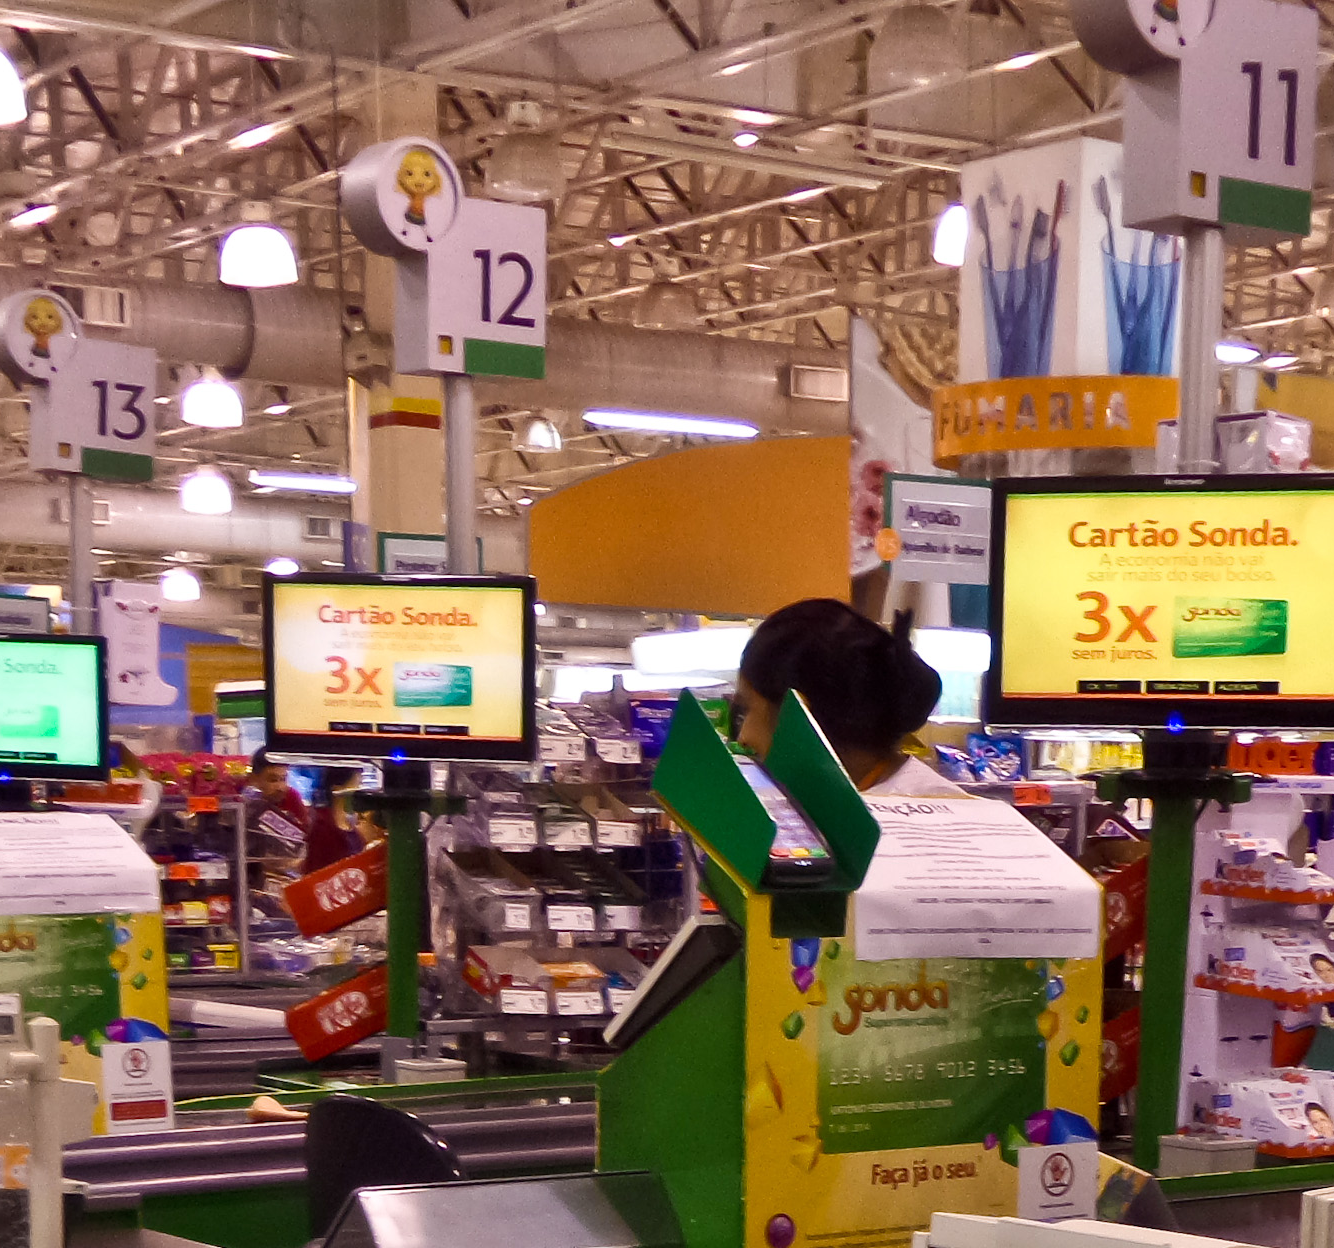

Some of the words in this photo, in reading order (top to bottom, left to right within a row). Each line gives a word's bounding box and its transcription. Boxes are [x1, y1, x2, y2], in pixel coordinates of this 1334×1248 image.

[1241, 61, 1298, 166] 11
[473, 249, 536, 328] 12
[92, 379, 147, 441] 13
[1069, 518, 1179, 548] Cartão
[1188, 518, 1300, 548] Sonda.
[318, 604, 396, 626] Cartão
[401, 606, 478, 627] Sonda.
[1074, 590, 1158, 644] 3x
[324, 655, 383, 696] 3x
[871, 1163, 910, 1191] Faça
[932, 1162, 944, 1180] o
